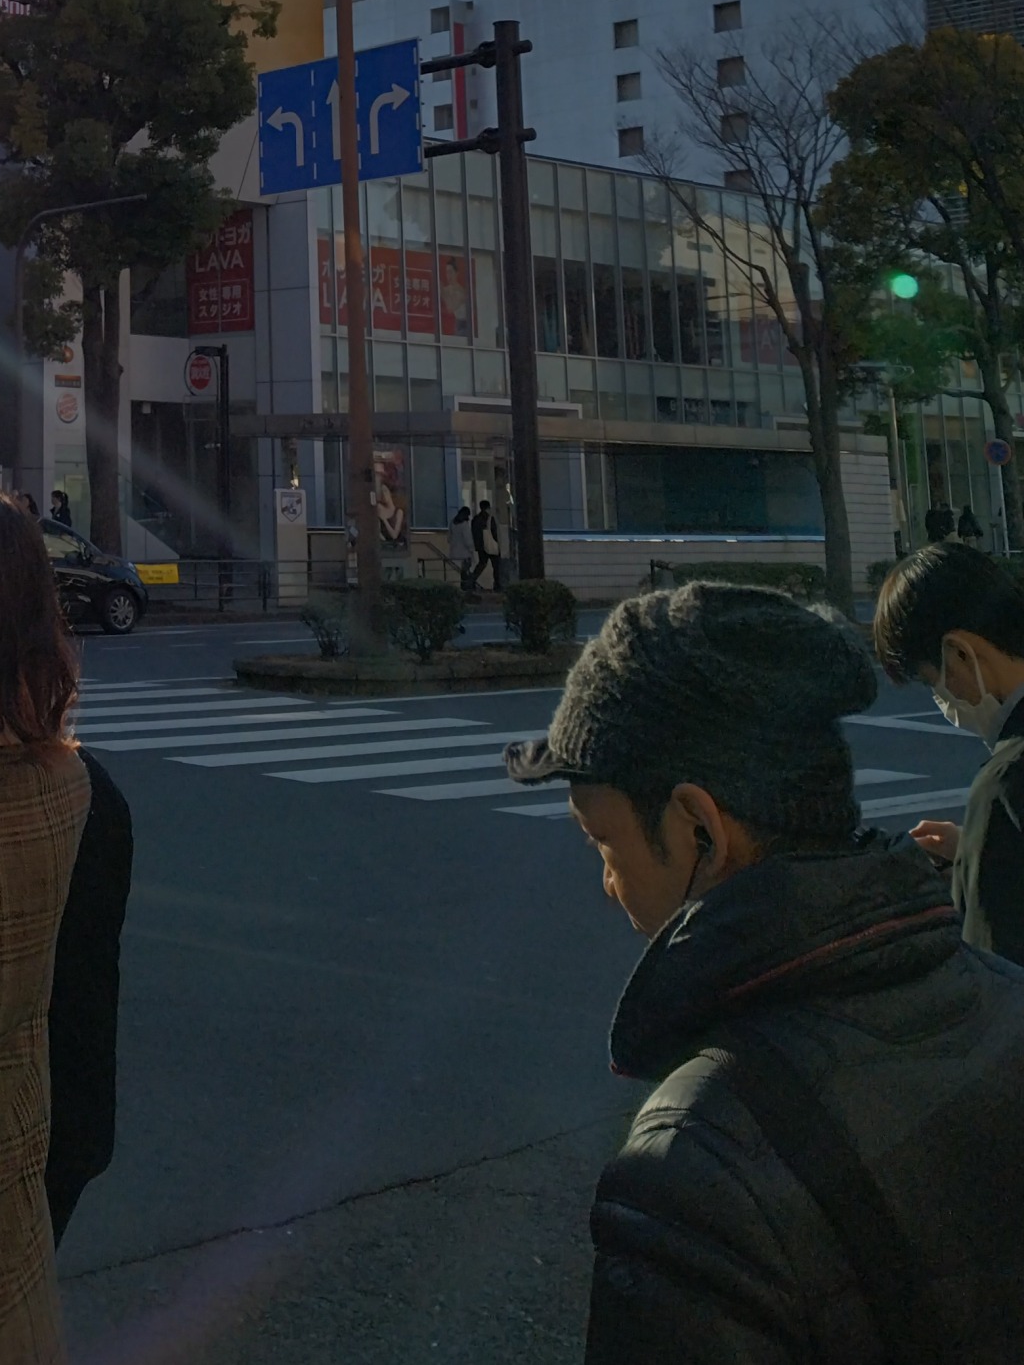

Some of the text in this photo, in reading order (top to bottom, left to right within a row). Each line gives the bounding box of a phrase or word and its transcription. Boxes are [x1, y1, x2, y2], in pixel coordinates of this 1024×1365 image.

[195, 249, 244, 273] LAVA
[198, 285, 242, 302] 女性専用
[322, 281, 388, 314] LAA
[198, 301, 242, 318] スタジオ
